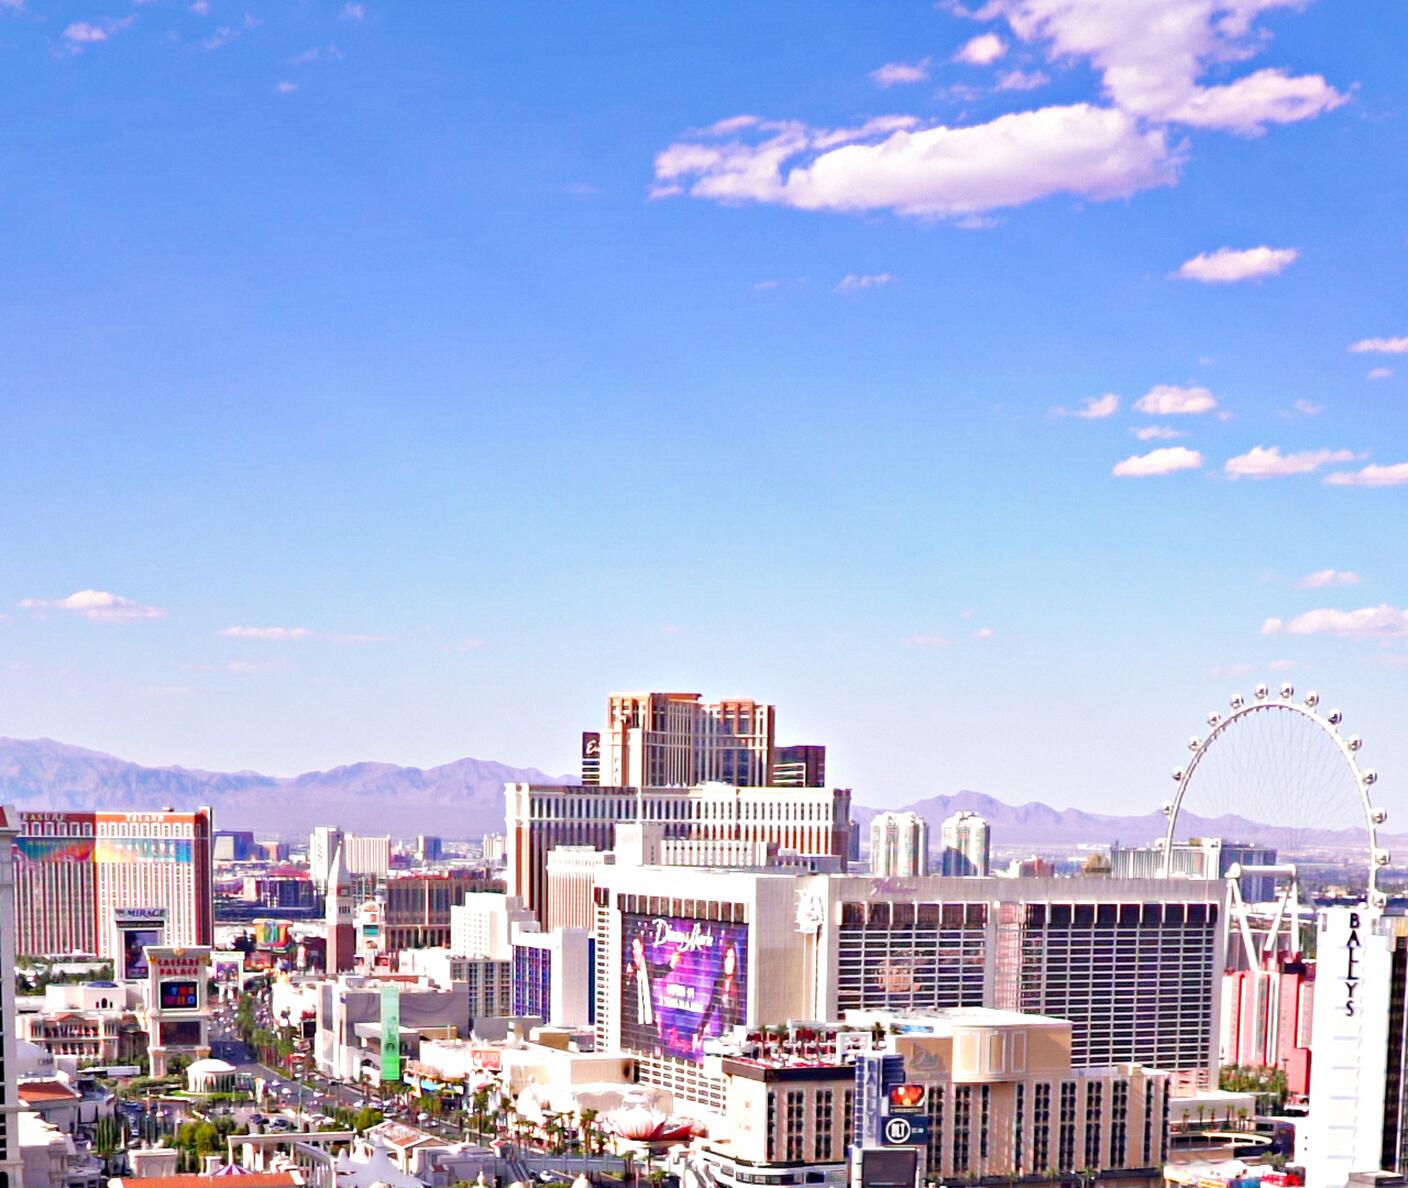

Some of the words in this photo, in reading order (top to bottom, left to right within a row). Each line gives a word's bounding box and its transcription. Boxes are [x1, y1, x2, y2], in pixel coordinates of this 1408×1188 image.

[19, 814, 65, 822] EASURE
[126, 814, 165, 822] ISLAND
[128, 908, 166, 918] MIRAGE
[1344, 912, 1361, 1017] BALLYS
